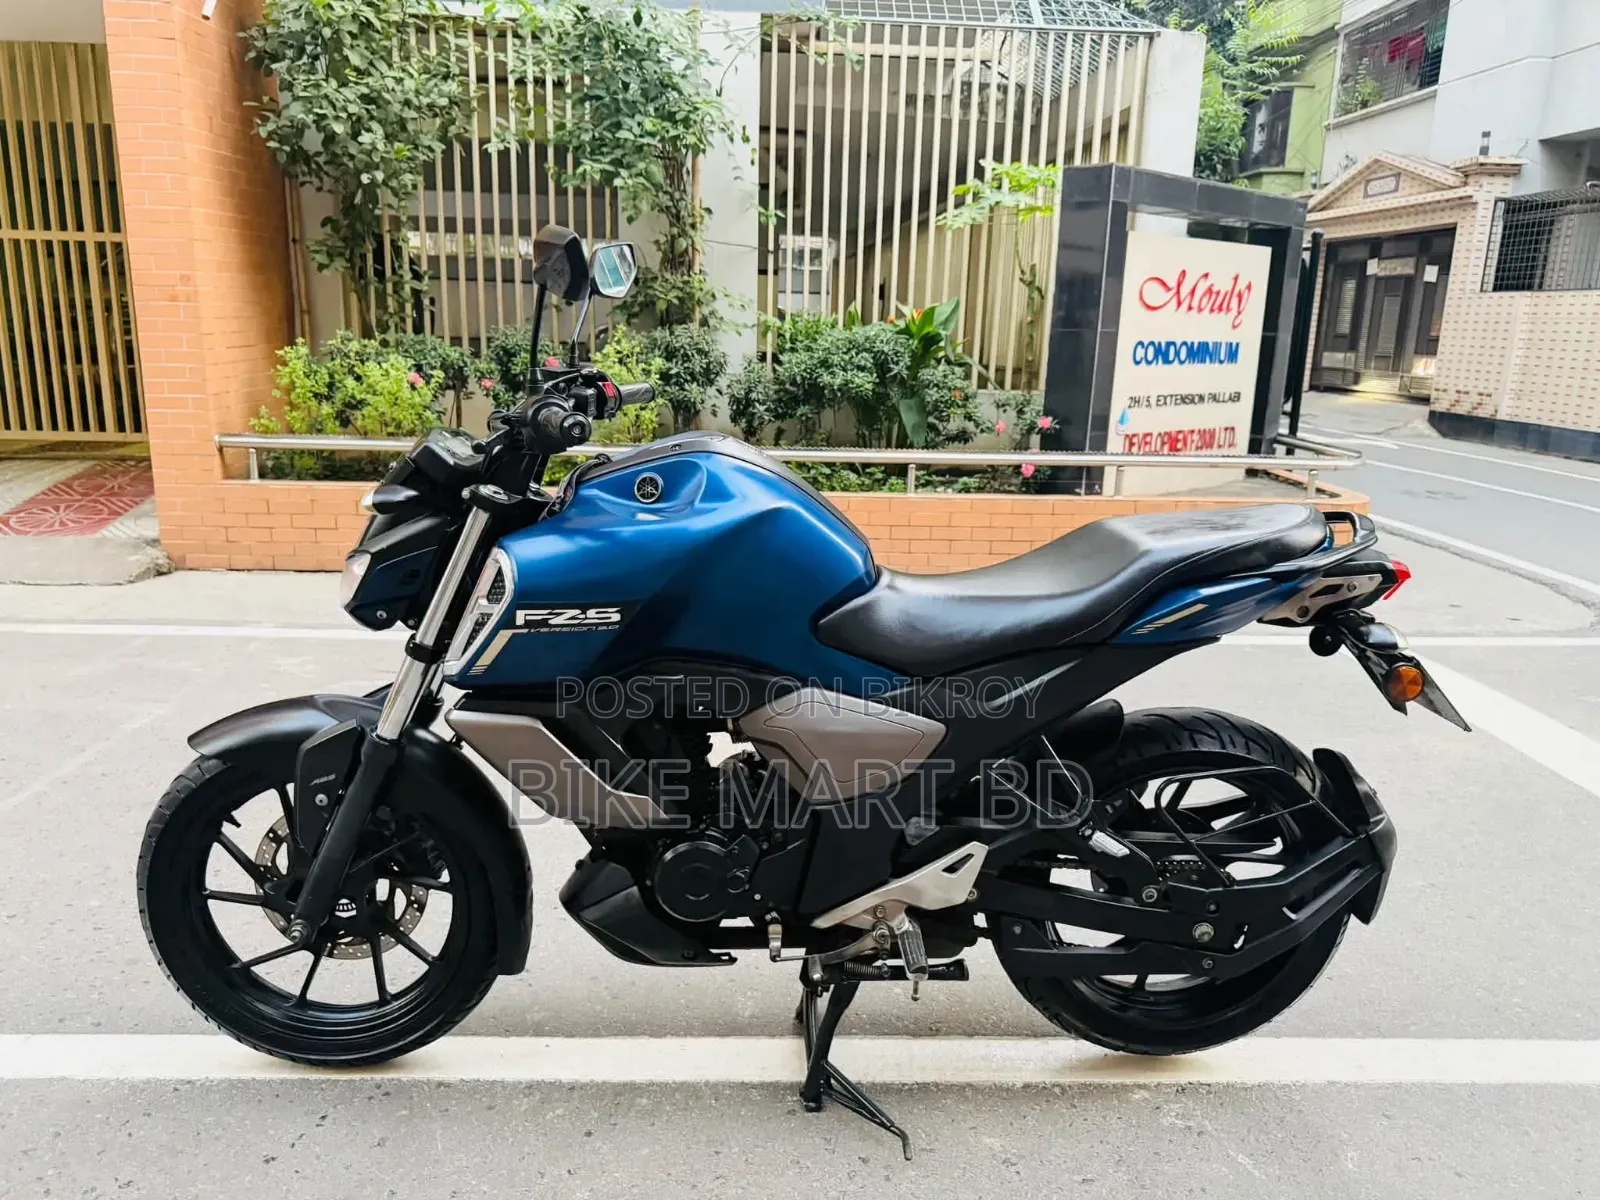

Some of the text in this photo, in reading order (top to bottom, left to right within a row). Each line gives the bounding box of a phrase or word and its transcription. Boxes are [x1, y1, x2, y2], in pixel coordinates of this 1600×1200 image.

[1138, 269, 1252, 330] Mouly
[1132, 340, 1240, 366] CONDOMINIUM
[1156, 393, 1205, 407] EXTENSION
